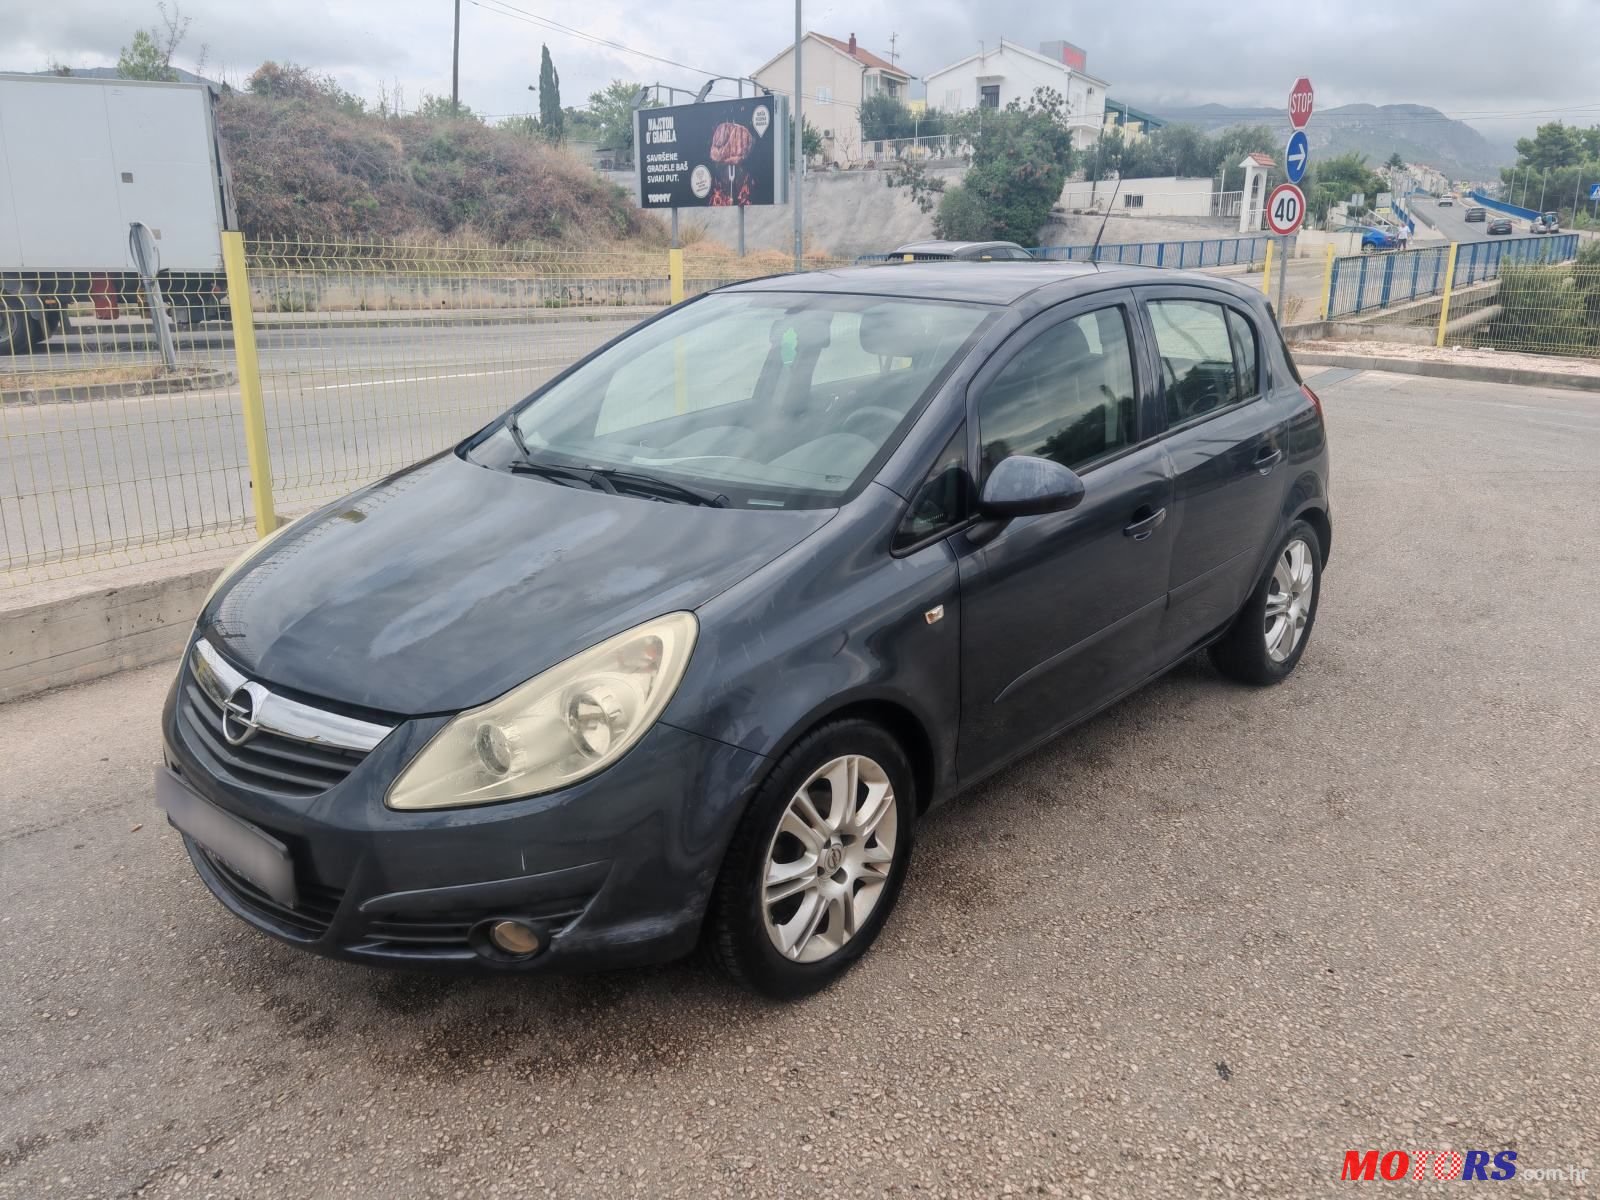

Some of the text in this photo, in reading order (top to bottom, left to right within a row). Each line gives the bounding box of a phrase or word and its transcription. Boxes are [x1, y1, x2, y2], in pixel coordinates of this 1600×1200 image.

[1292, 93, 1312, 113] STOP
[646, 152, 678, 163] SAVRŠENE
[647, 160, 689, 173] GRADELE BAŠ
[648, 174, 664, 184] SVAKI
[1275, 198, 1296, 221] 40
